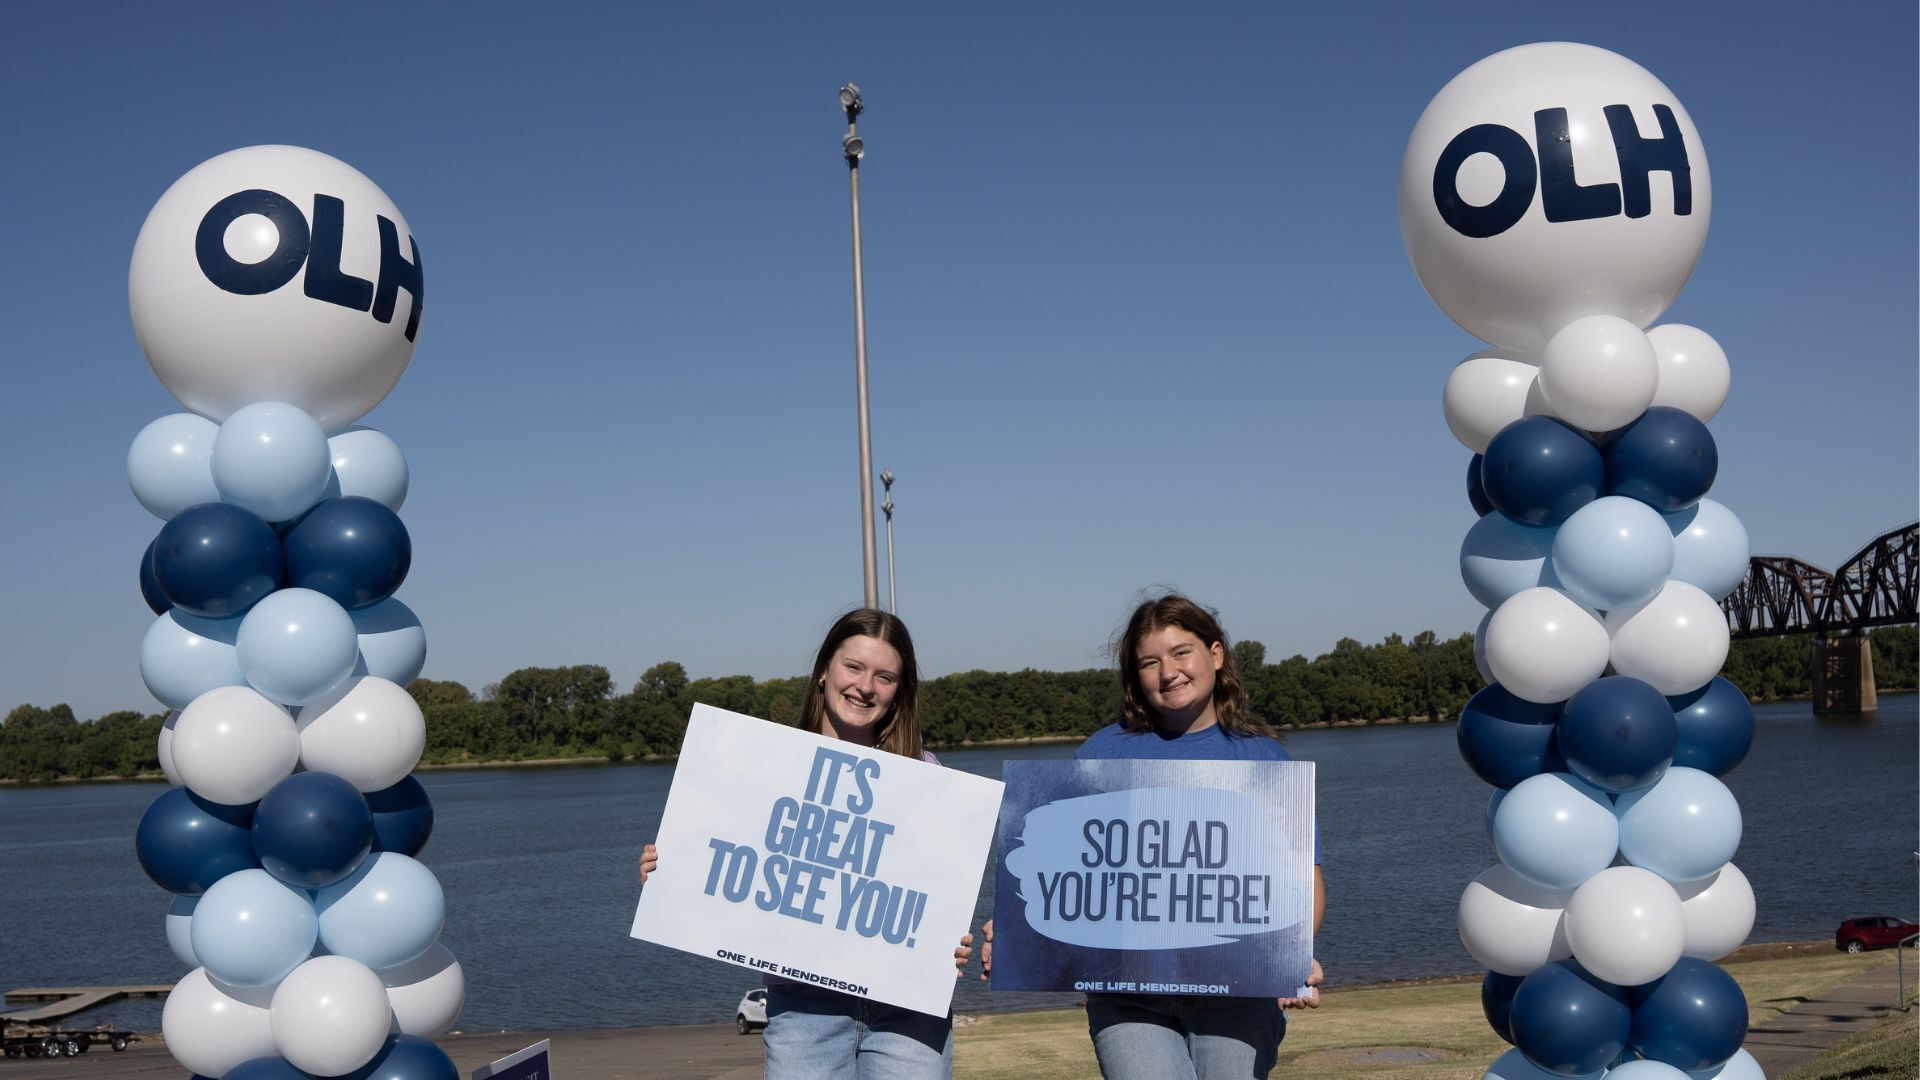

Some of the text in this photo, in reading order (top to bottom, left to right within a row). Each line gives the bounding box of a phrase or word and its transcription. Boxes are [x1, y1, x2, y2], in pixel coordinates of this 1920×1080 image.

[1433, 104, 1692, 238] OLH
[195, 189, 424, 343] OLH
[804, 746, 880, 814] IT'S
[765, 797, 895, 877] GREAT
[1081, 819, 1228, 869] SO GLAD
[704, 838, 928, 948] TO SEE YOU!
[1037, 872, 1270, 925] YOU'RE HERE!
[716, 949, 868, 995] ONE LIFE HENDERSON
[1074, 981, 1229, 994] ONE LIFE HENDERSON
